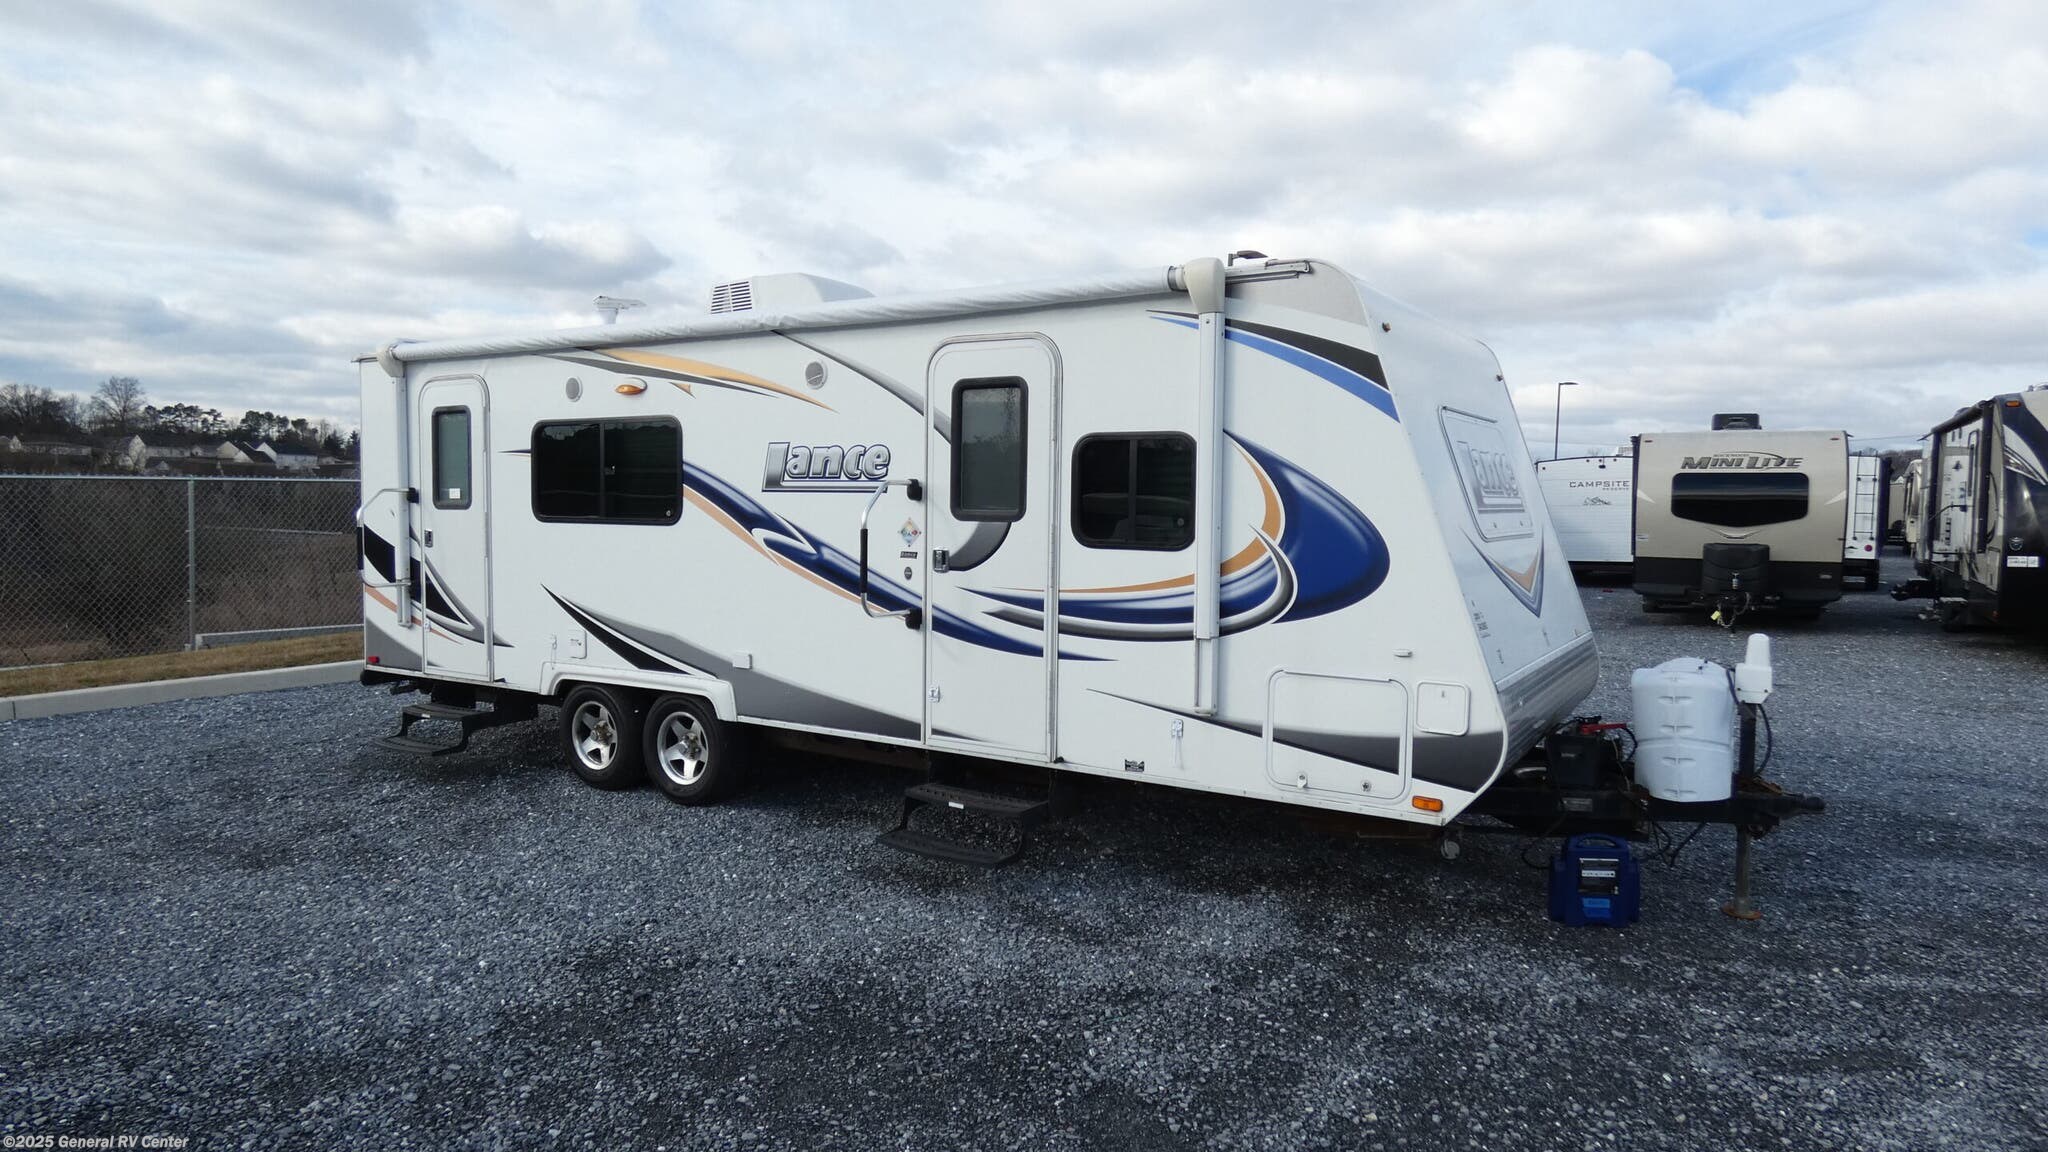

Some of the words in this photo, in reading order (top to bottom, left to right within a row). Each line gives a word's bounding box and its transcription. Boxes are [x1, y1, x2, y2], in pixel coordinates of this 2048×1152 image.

[762, 441, 891, 493] Lance
[1680, 456, 1744, 470] MINI
[1745, 456, 1803, 470] LITE
[1569, 480, 1631, 488] CAMPSITE
